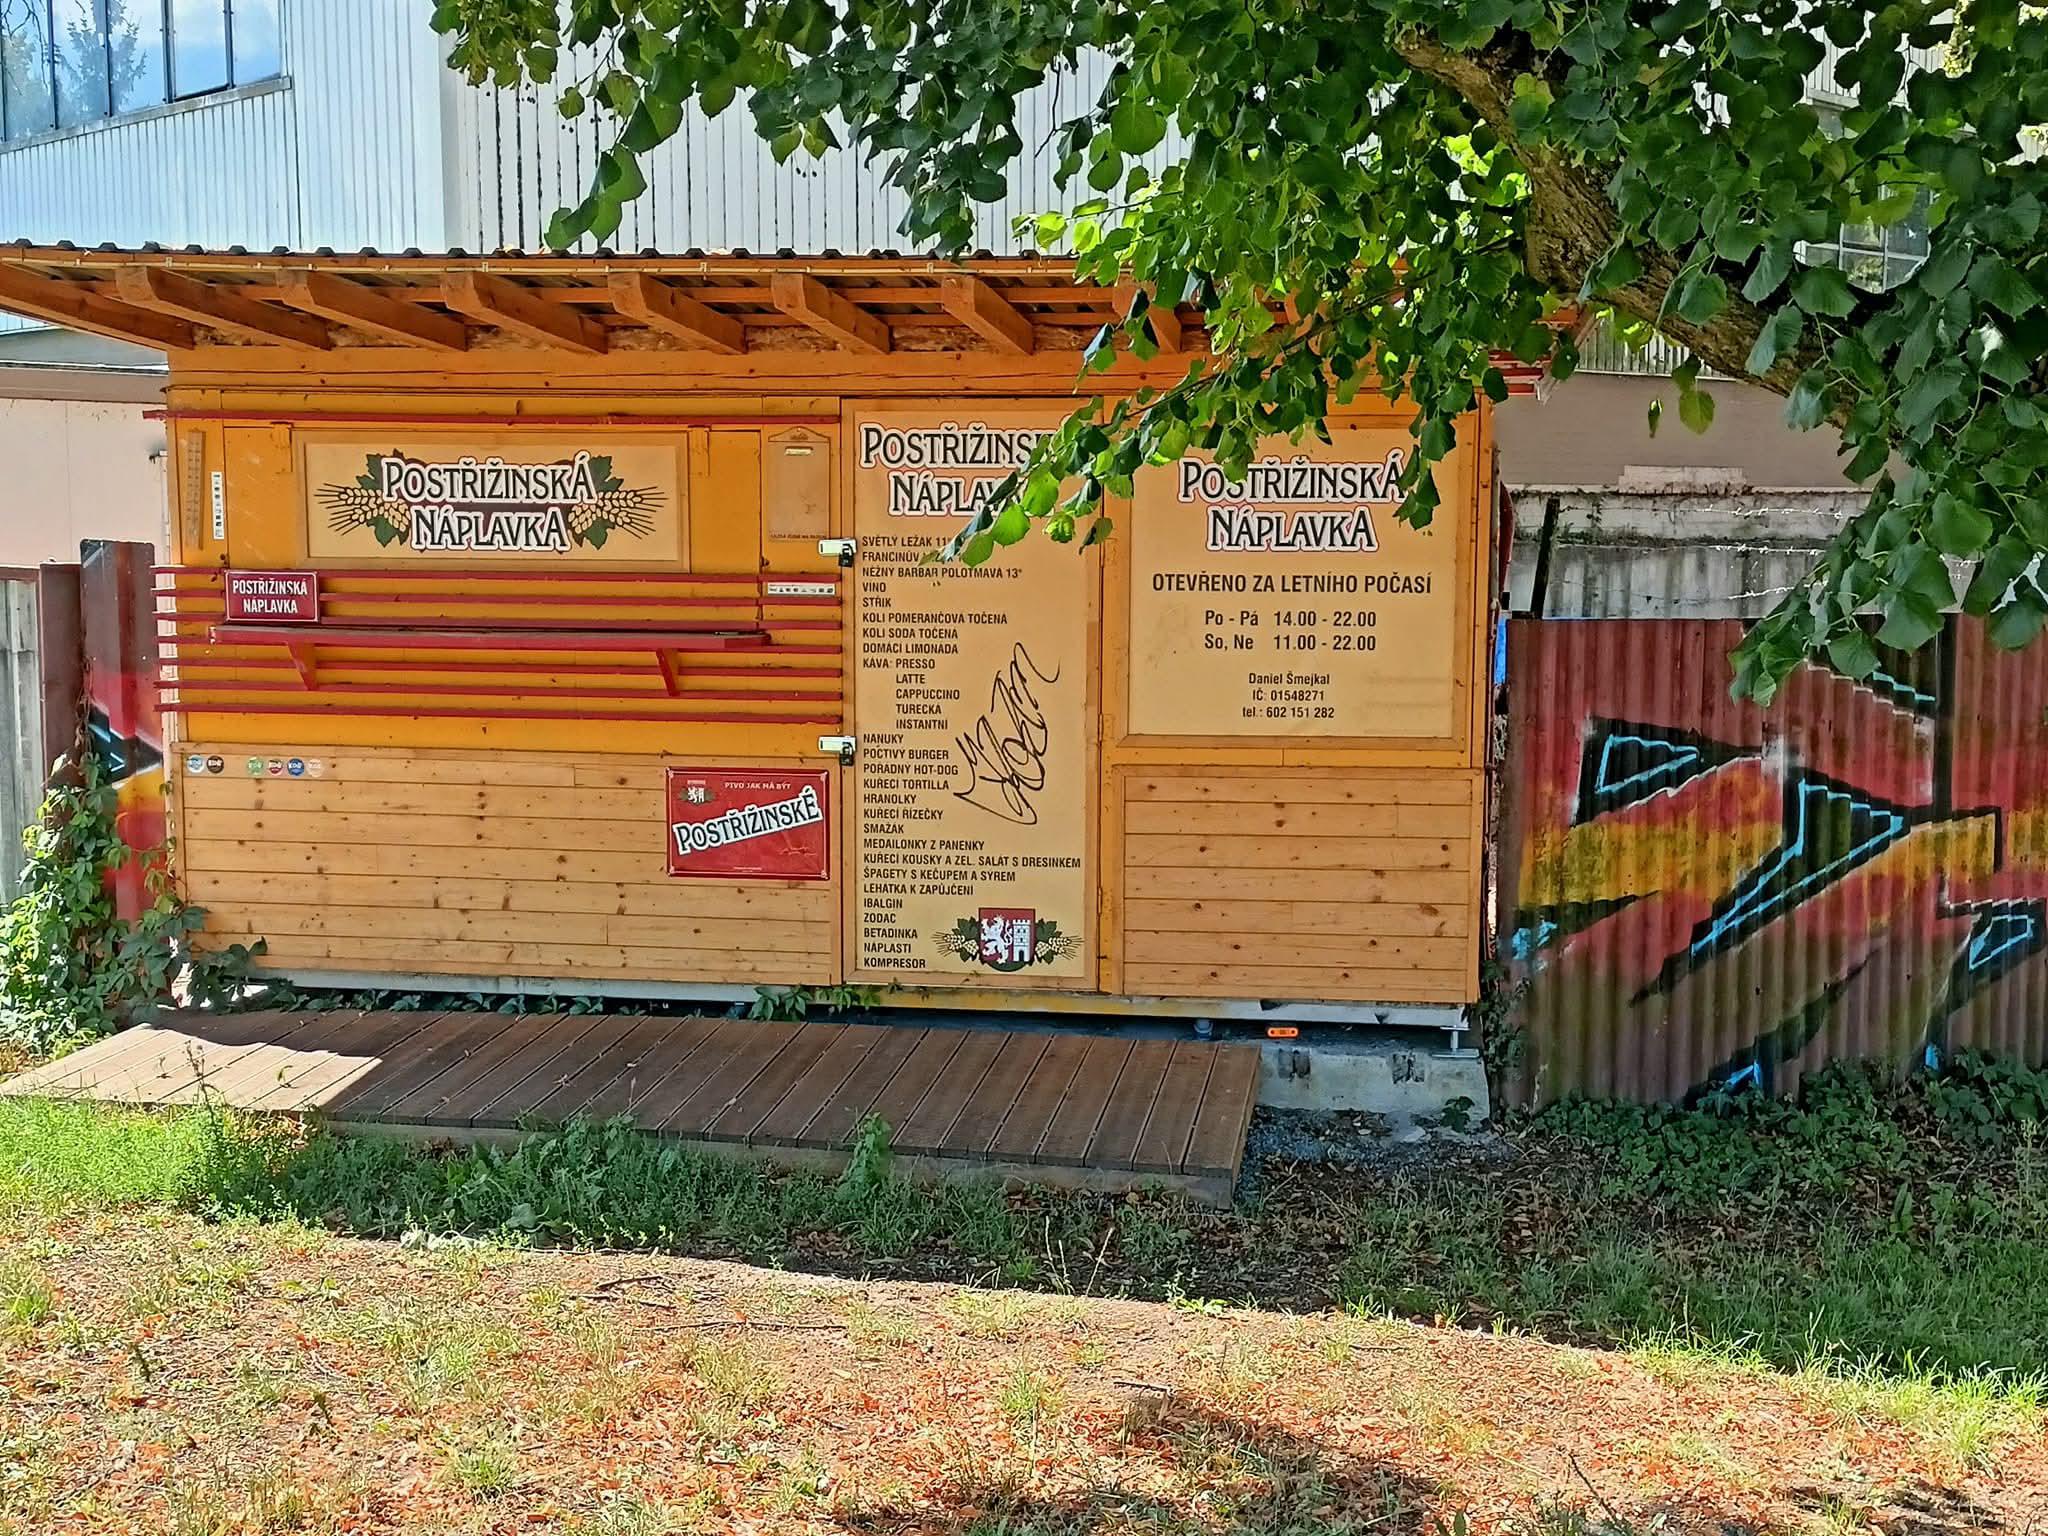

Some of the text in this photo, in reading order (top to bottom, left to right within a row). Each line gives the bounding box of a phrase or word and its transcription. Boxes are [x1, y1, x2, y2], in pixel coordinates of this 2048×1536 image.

[863, 425, 1056, 465] POSTŘIŽINS
[384, 454, 594, 500] POSTŘIŽINSKÁ
[413, 506, 567, 547] NÁPLAVKA
[1210, 507, 1375, 547] NÁPLAVKA
[232, 577, 308, 596] POSTŘIŽINSKÁ
[1152, 570, 1431, 594] OTEVŘENO ZA LETNÍHO POČASÍ
[243, 597, 298, 614] NÁPLAVKA
[1205, 609, 1223, 626] Po
[1239, 610, 1258, 627] Pá
[1273, 610, 1316, 627] 14.00
[1332, 610, 1376, 627] 22.00
[888, 627, 915, 639] SODA
[1204, 633, 1227, 651] So,
[1233, 633, 1253, 650] Ne
[1273, 634, 1316, 651] 11.00
[1332, 634, 1375, 651] 22.00
[895, 658, 935, 670] PRESSO
[895, 673, 925, 685] LATTE
[1248, 670, 1329, 687] Daniel Šmejkal
[895, 688, 960, 701] CAPPUCCINO
[1270, 689, 1323, 702] 01548271
[1265, 705, 1287, 719] 602
[1290, 705, 1309, 719] 151
[1313, 705, 1335, 720] 282
[908, 748, 948, 761] BURGER
[913, 764, 958, 776] HOT-DOG
[724, 781, 745, 789] PIVO
[746, 781, 761, 790] JAK
[901, 778, 949, 791] TORTILLA
[863, 793, 916, 805] HRANOLKY
[676, 788, 820, 852] POSTŘIŽINSKÉ
[863, 838, 984, 851] MEDAILONKY Z PANENKY
[902, 853, 942, 865] KOUSKY
[944, 855, 951, 865] A
[1011, 856, 1018, 868] S
[1021, 856, 1080, 869] DRESINKEM
[910, 868, 917, 880] S
[970, 870, 977, 881] A
[909, 883, 916, 895] K
[863, 897, 902, 909] IBALGIN
[863, 912, 896, 924] ZODAC
[863, 927, 918, 939] BETADINKA
[863, 956, 926, 970] KOMPRESOR
